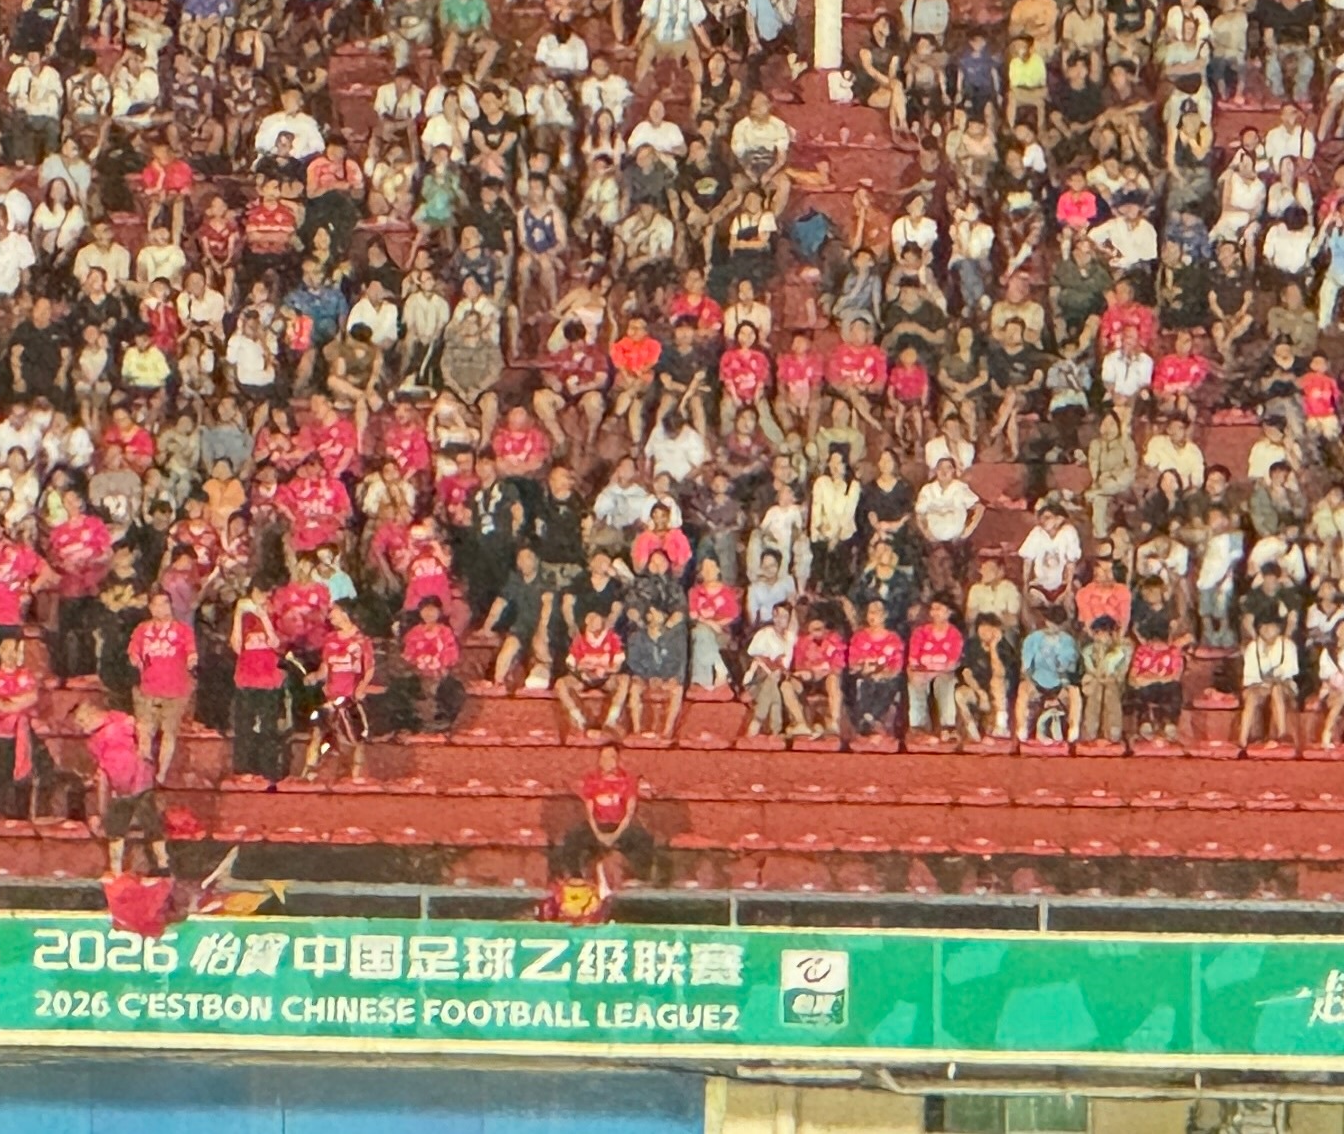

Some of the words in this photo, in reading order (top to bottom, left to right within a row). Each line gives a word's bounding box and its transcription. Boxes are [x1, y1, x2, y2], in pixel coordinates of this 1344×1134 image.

[33, 928, 179, 973] 2026
[35, 990, 110, 1018] 2026
[117, 992, 272, 1020] C'ESTBON
[281, 996, 415, 1025] CHINESE
[423, 998, 590, 1028] FOOTBALL
[597, 1002, 740, 1031] LEAGUE2
